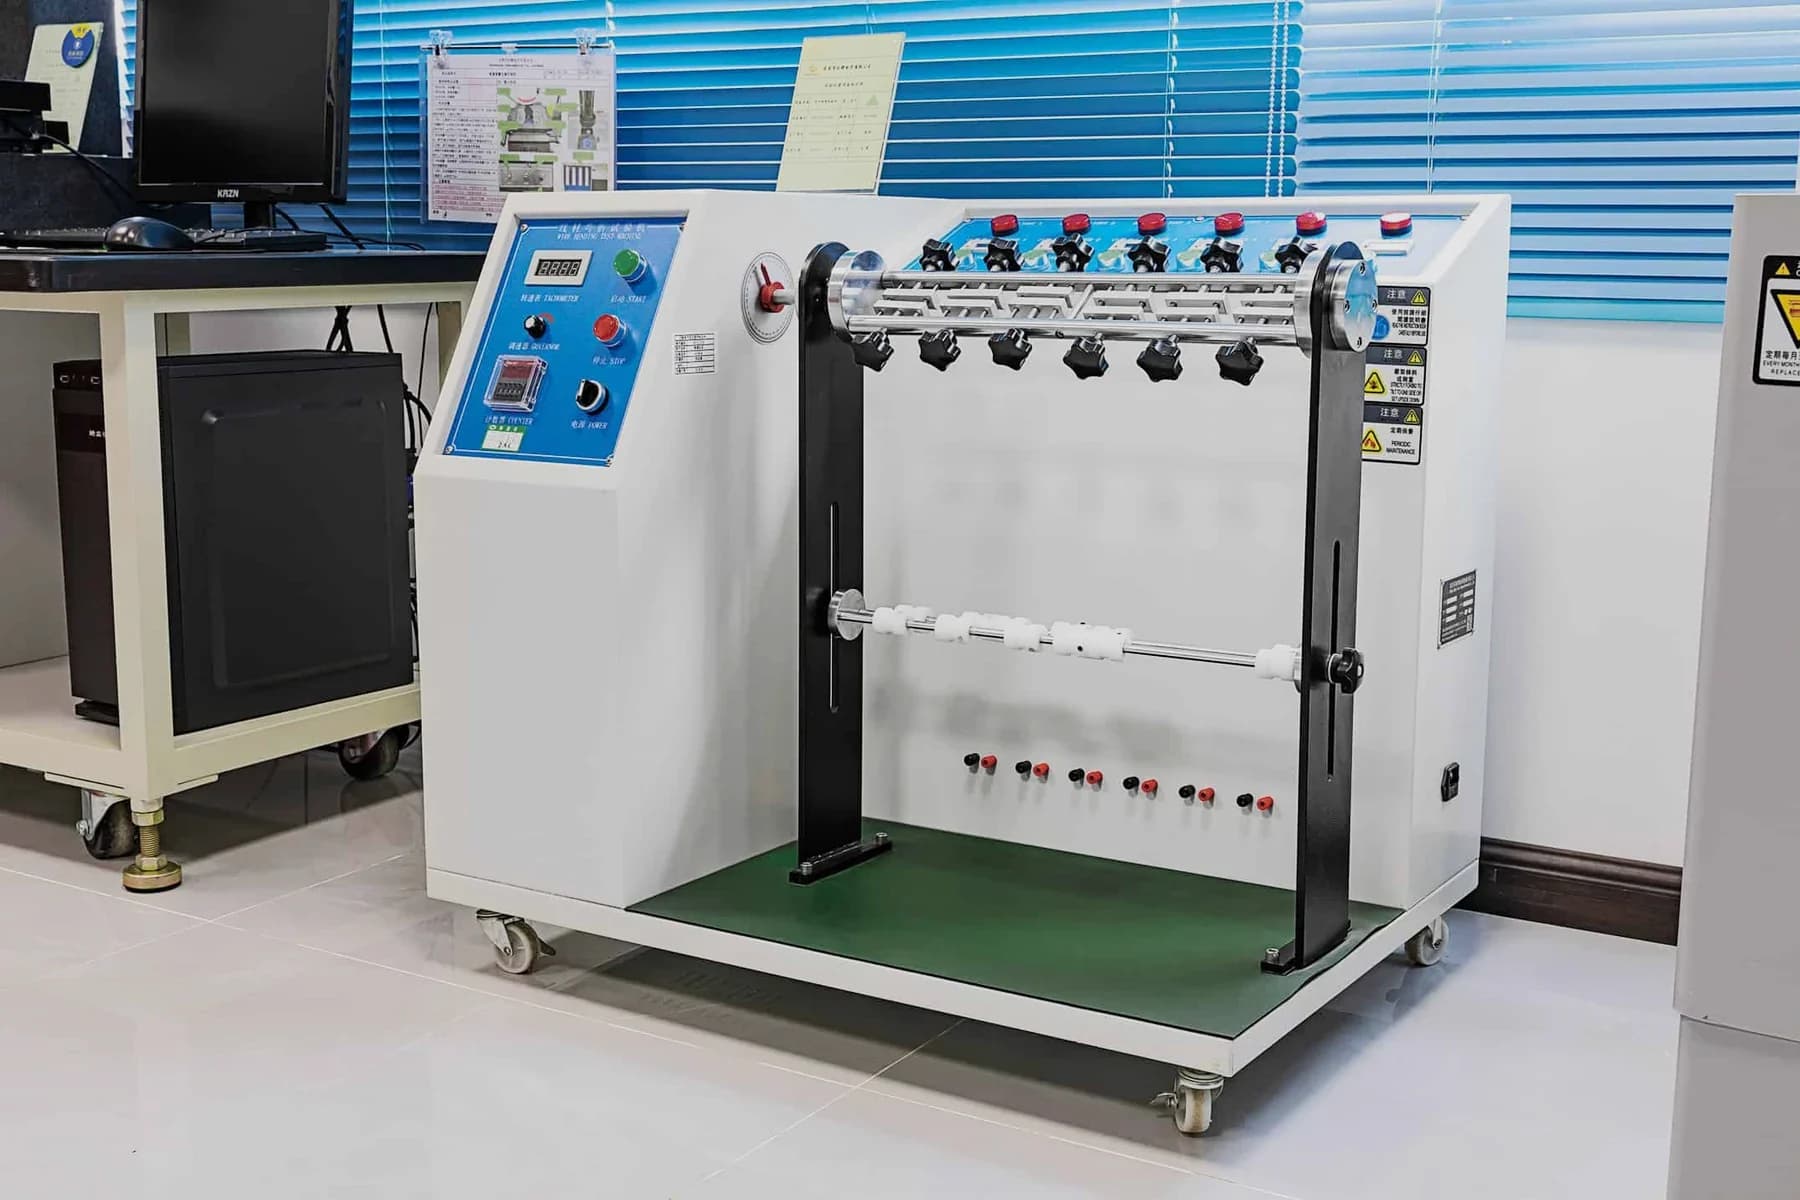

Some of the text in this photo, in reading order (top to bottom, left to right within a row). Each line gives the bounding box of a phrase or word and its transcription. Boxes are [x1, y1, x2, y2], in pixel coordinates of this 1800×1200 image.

[1386, 288, 1406, 299] 注意
[1383, 348, 1403, 359] 注意
[1380, 407, 1400, 417] 注意
